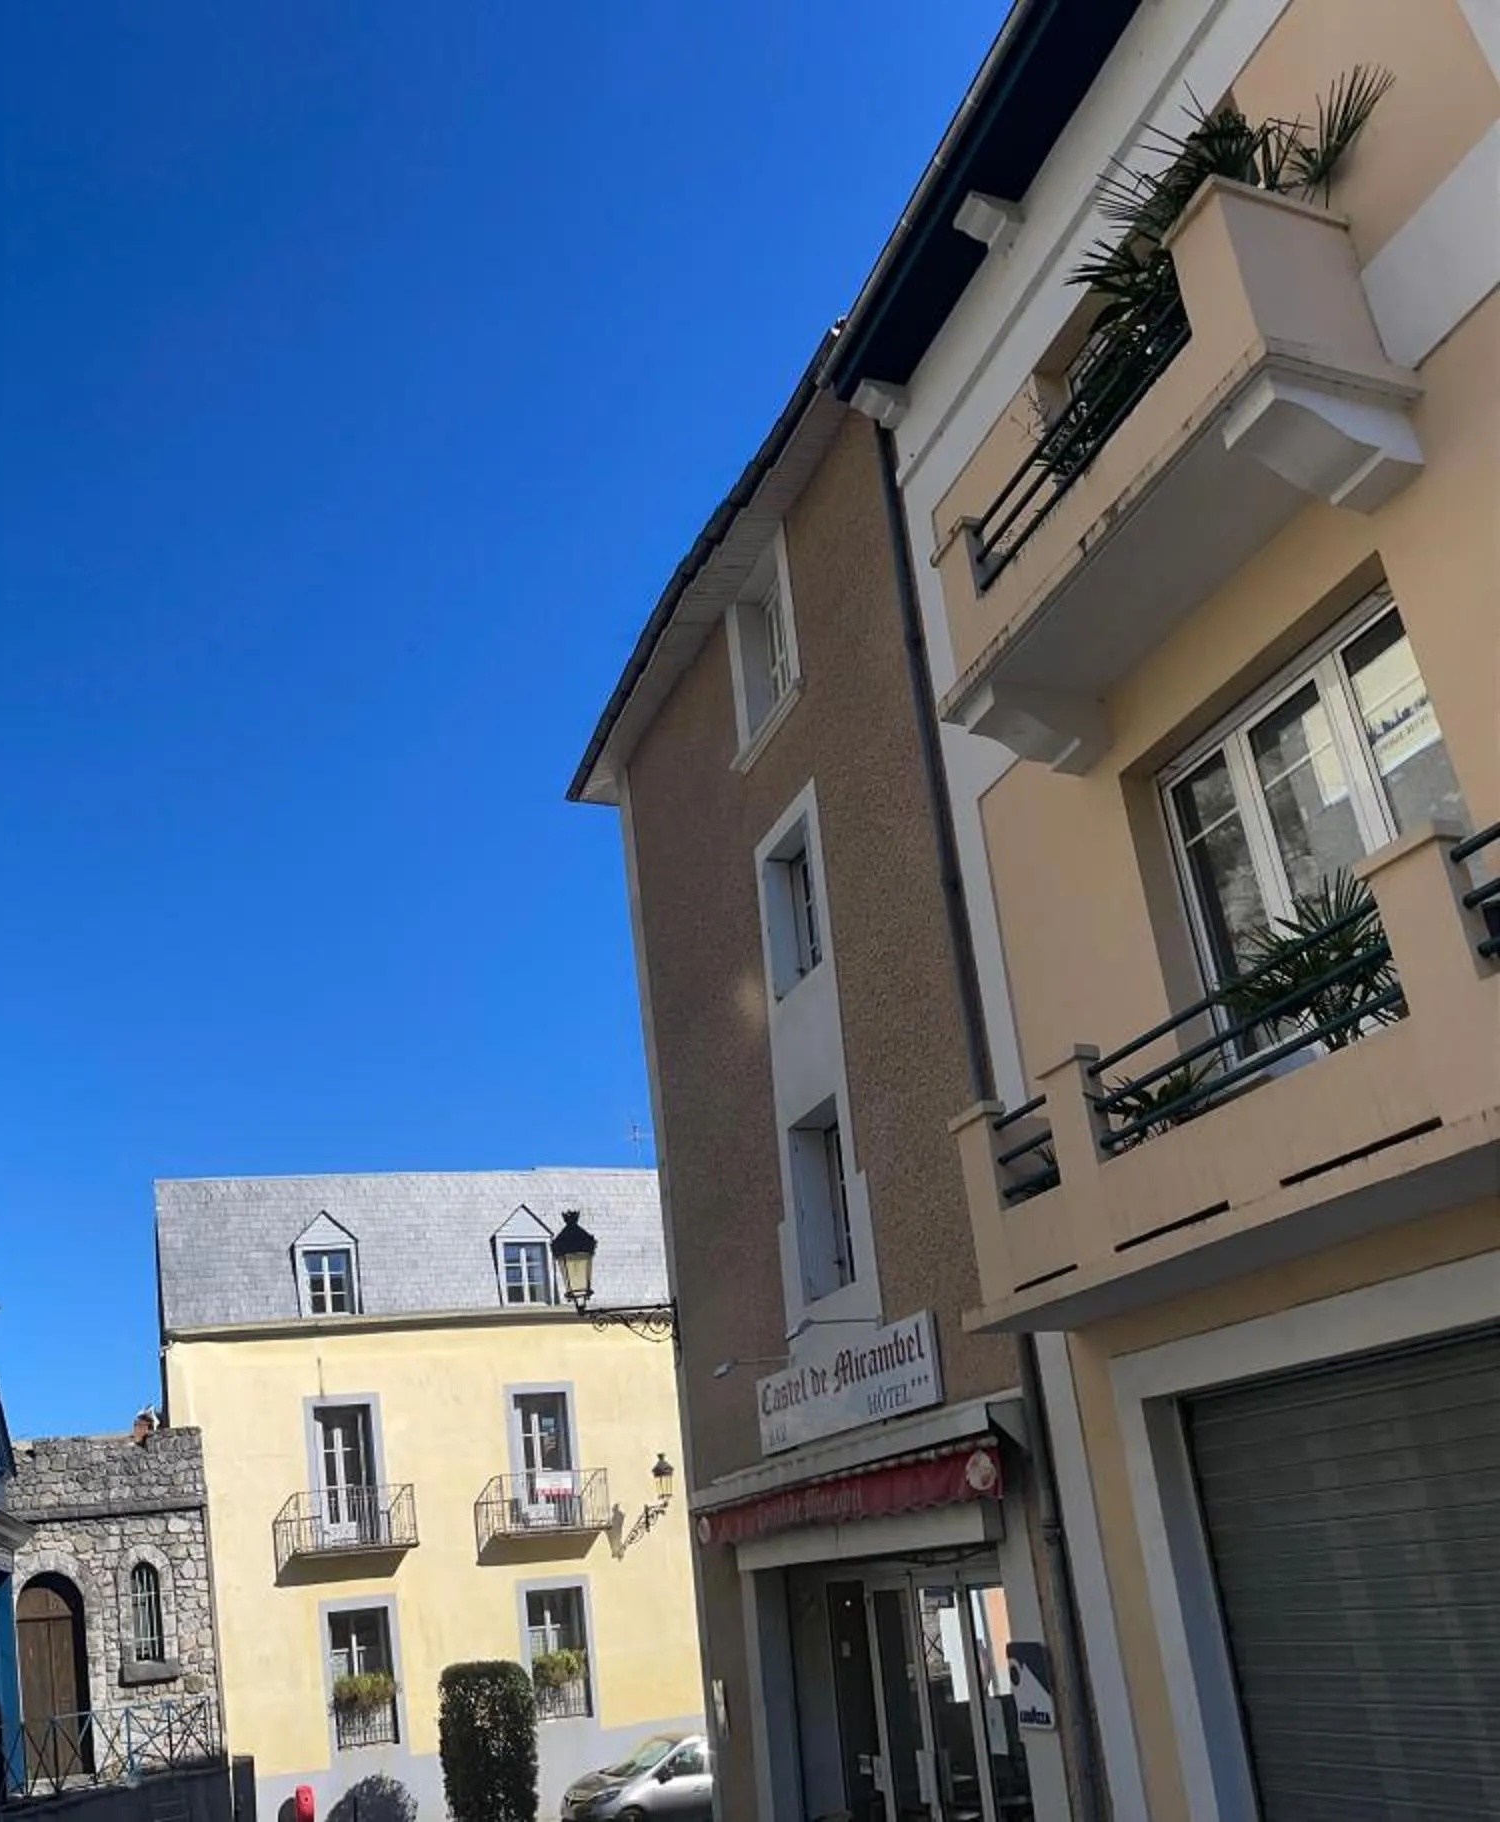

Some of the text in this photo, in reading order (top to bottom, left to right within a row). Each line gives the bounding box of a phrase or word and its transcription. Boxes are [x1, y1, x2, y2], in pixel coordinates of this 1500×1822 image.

[761, 1322, 925, 1416] Castel de Mirambel
